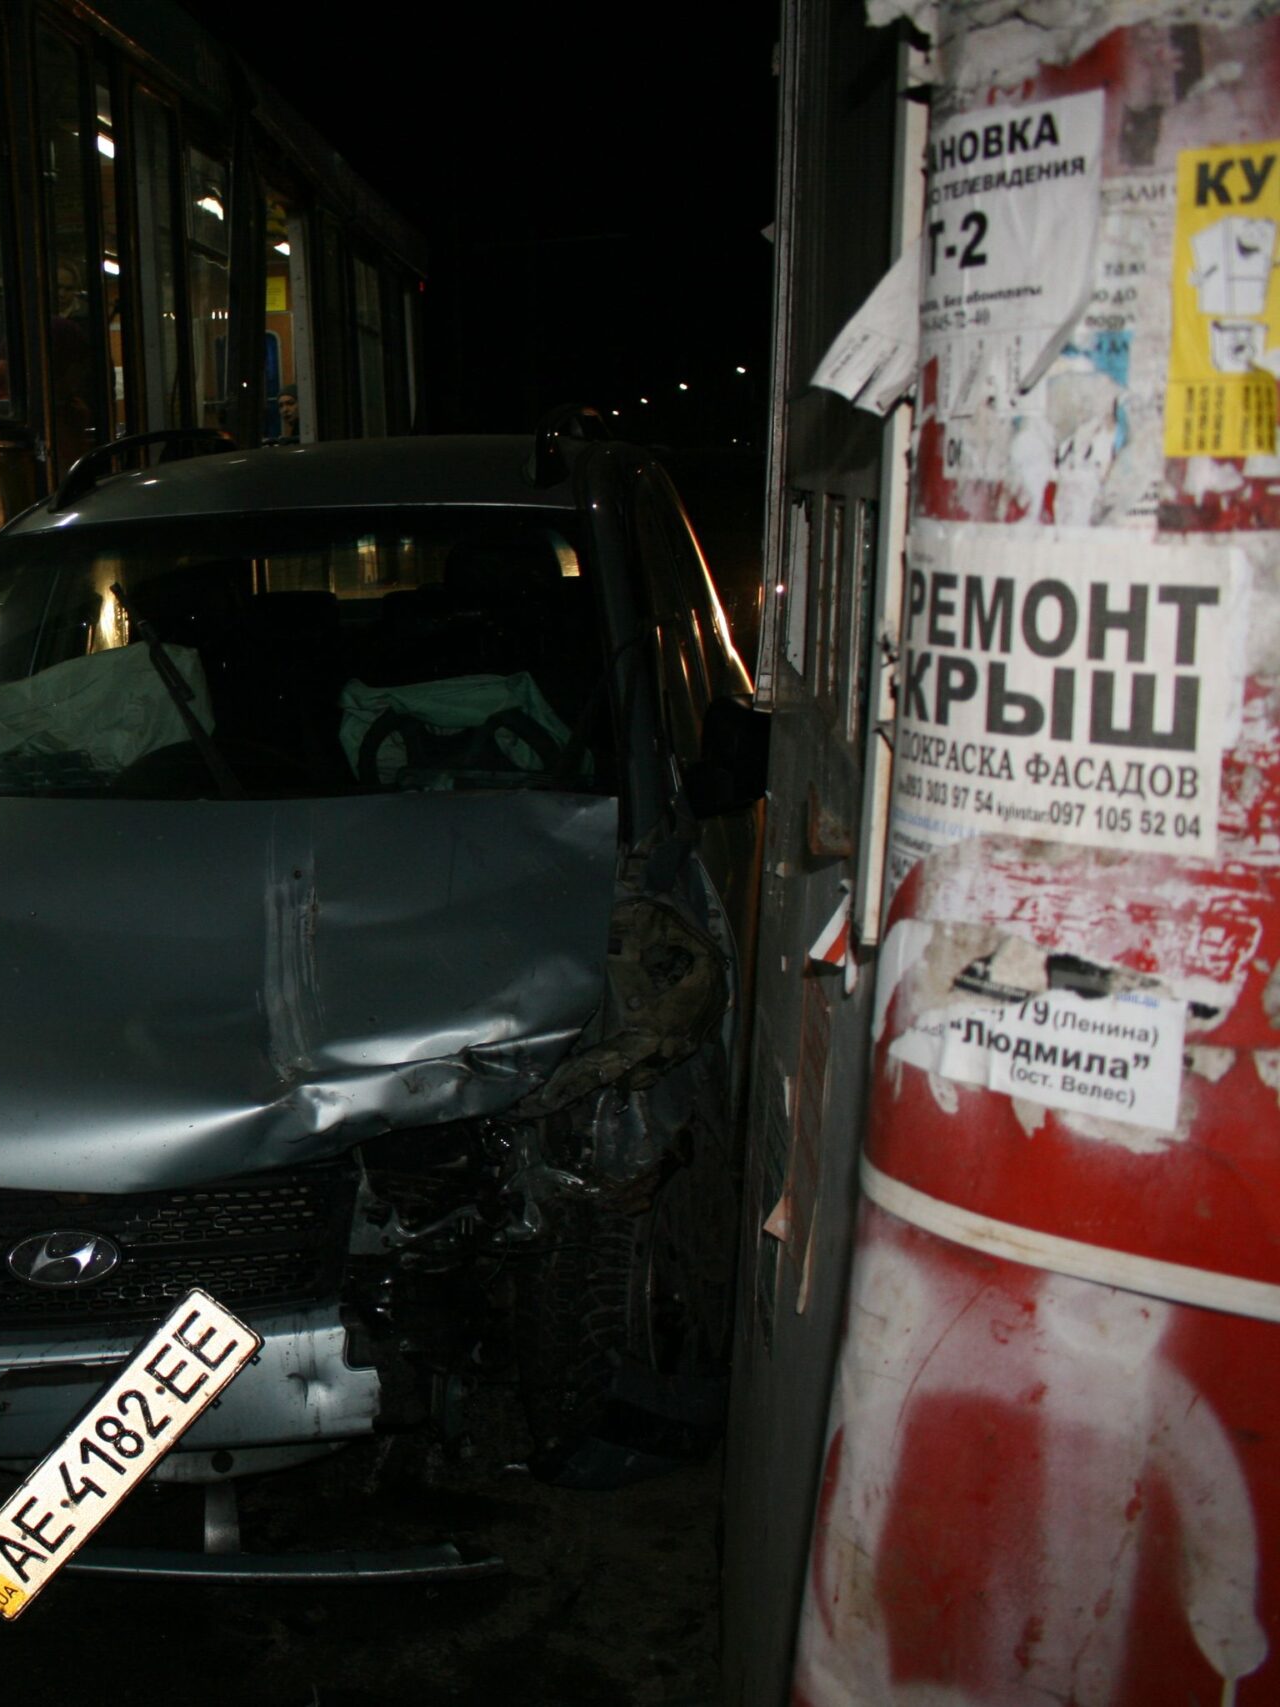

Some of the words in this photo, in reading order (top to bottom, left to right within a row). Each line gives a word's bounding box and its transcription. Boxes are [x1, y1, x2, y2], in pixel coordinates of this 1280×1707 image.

[1195, 154, 1277, 207] КУ
[908, 568, 1220, 667] РЕМОНТ
[903, 647, 1200, 753] КРЫШ
[900, 727, 1015, 782] ПОКРАСКА
[1025, 753, 1200, 801] ФАСАДОВ
[975, 787, 994, 815] 54
[1094, 804, 1133, 832] 105
[1140, 809, 1167, 836] 52
[1173, 813, 1202, 840] 04
[1053, 1010, 1160, 1048] (Ленина)
[1009, 1062, 1054, 1089] (ост.
[1060, 1075, 1137, 1109] Велес)
[59, 1389, 172, 1499] 4182
